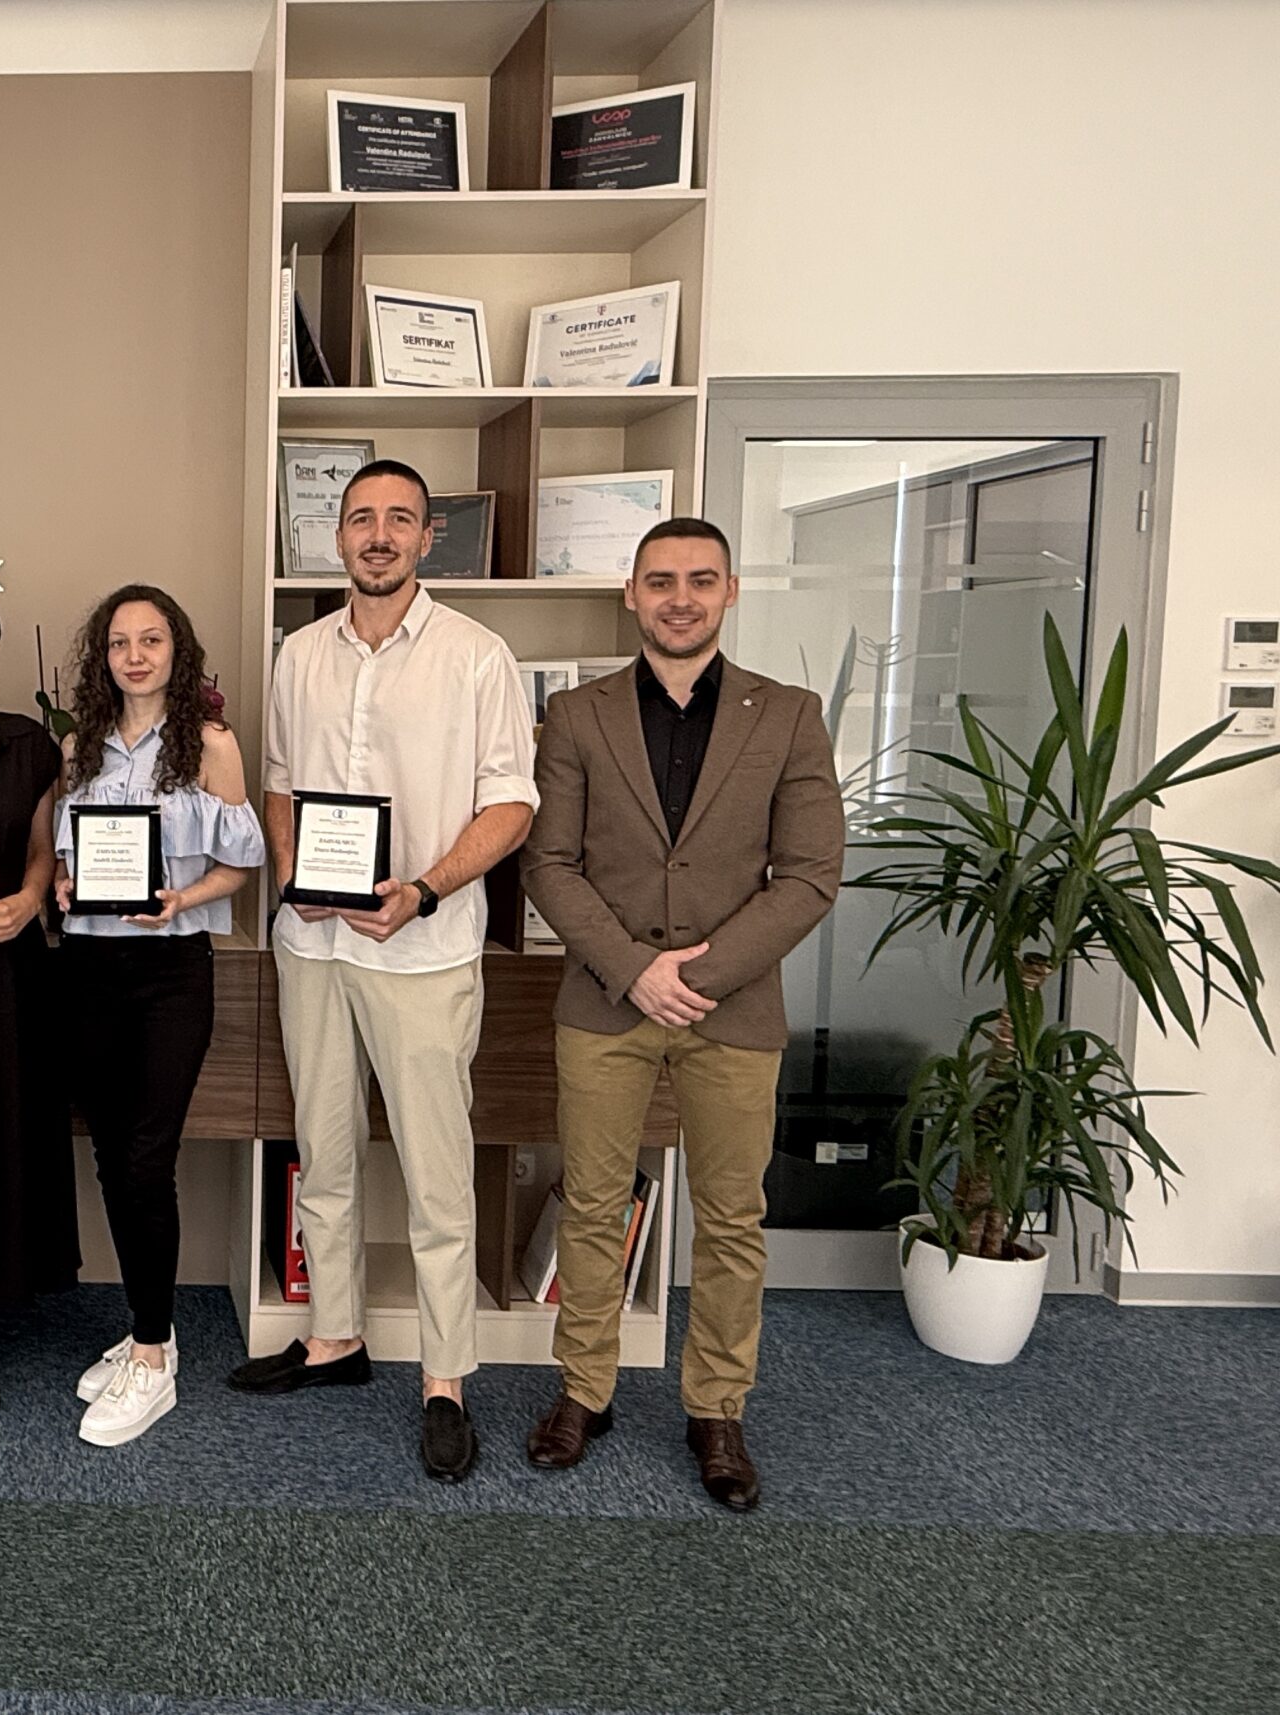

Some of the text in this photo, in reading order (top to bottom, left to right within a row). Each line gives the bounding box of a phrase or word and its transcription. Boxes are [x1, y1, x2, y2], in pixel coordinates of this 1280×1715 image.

[566, 314, 636, 335] CERTIFICATE
[402, 334, 455, 350] SERTIFIKAT
[560, 346, 597, 358] Valentina
